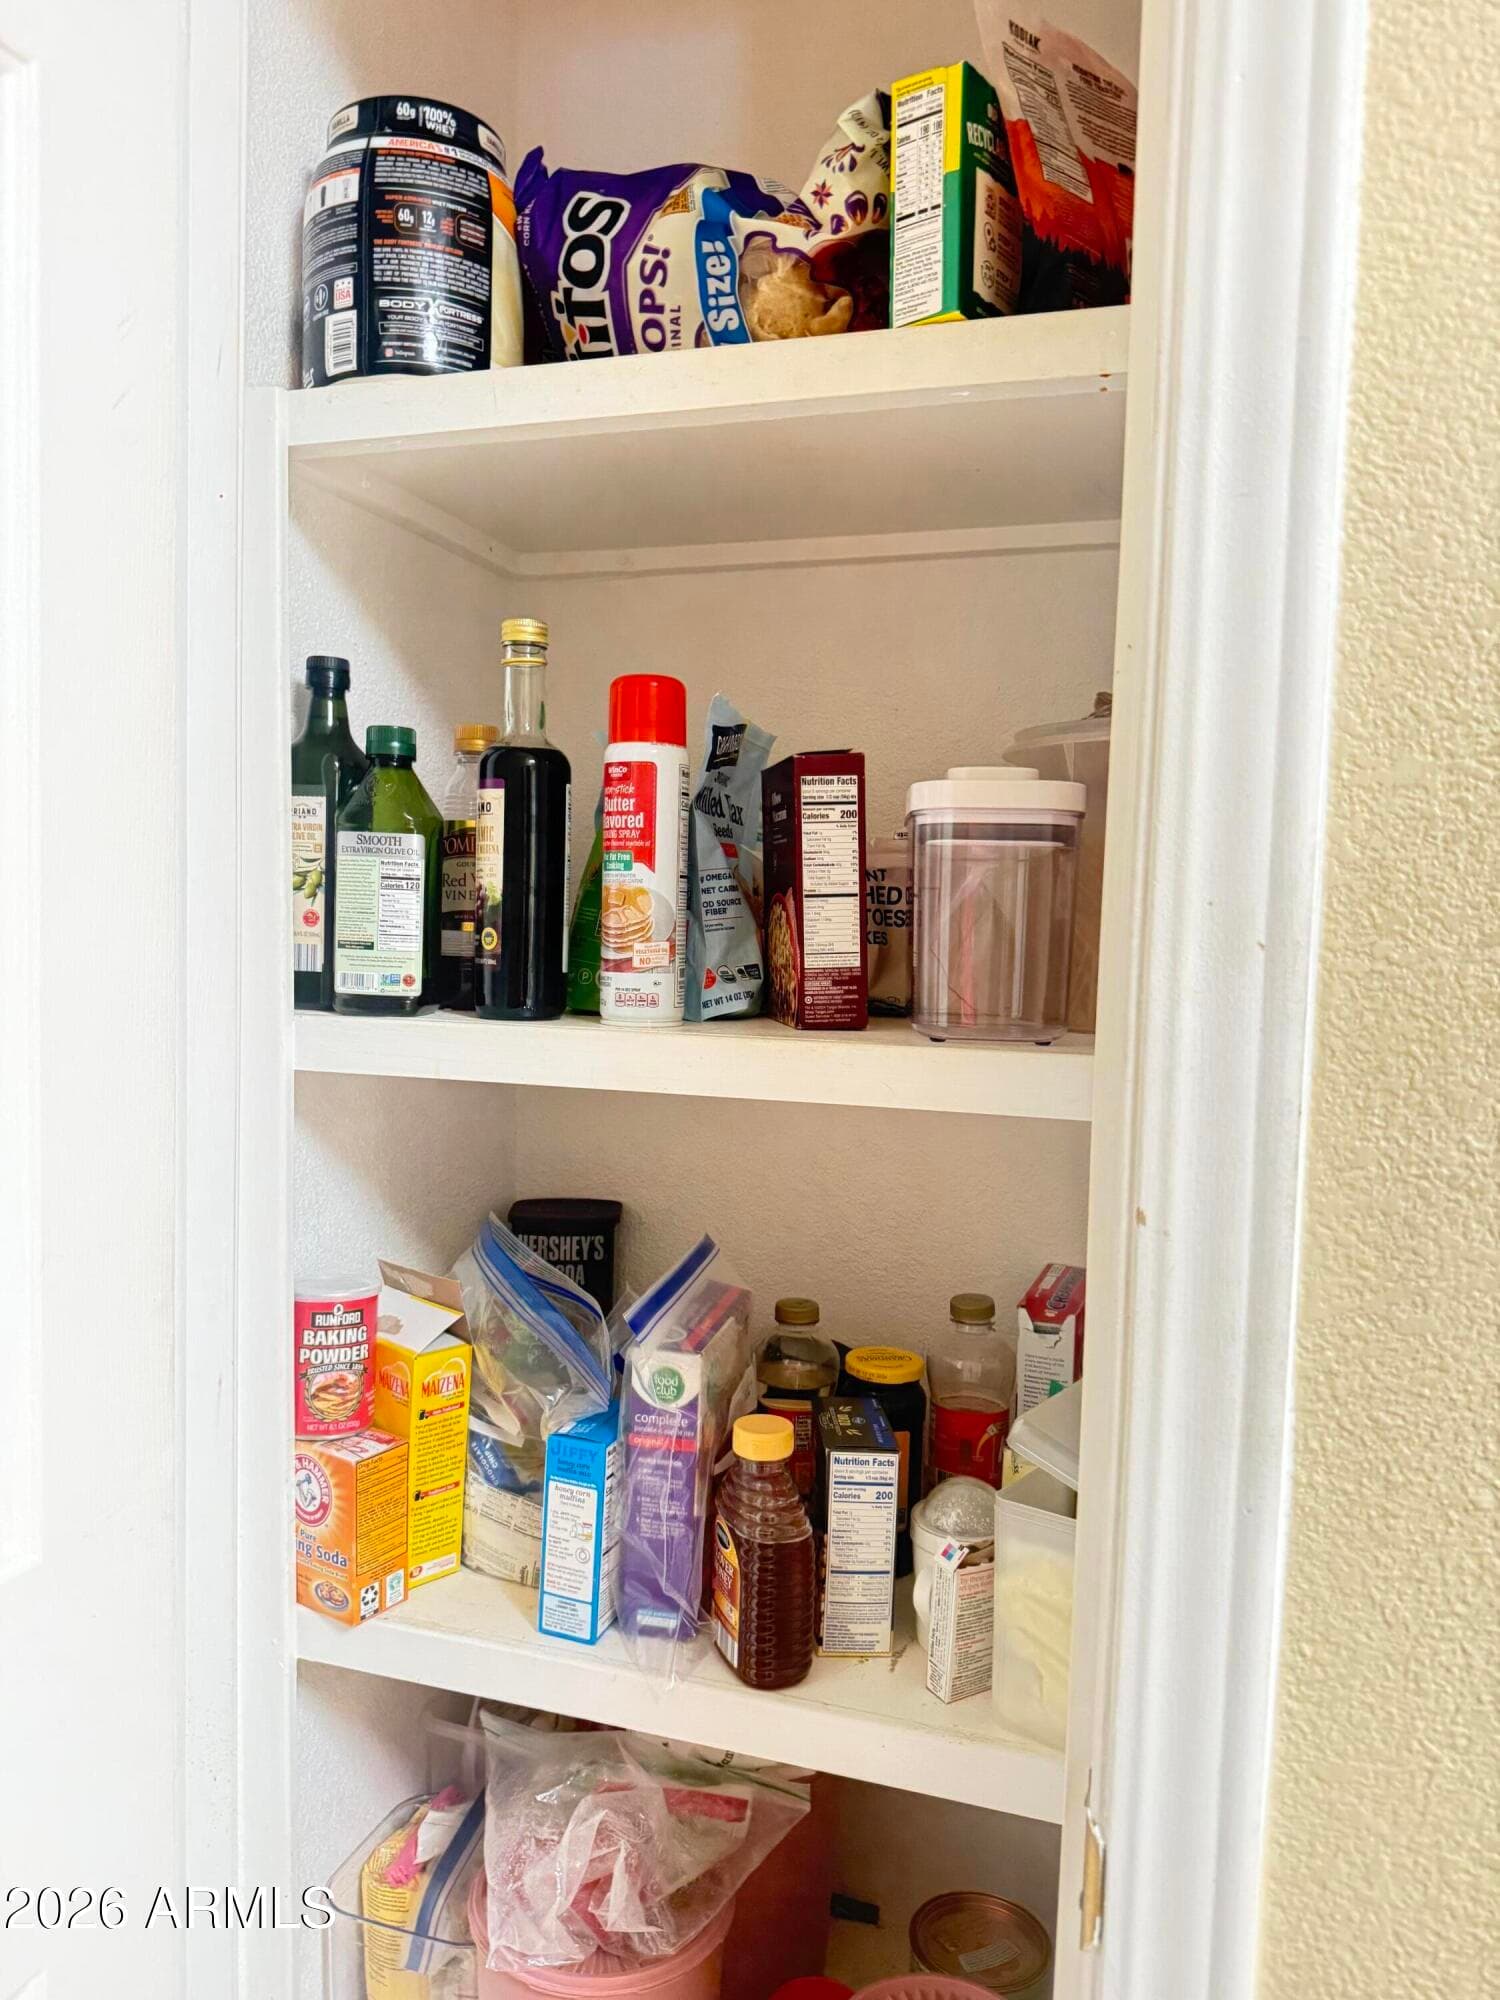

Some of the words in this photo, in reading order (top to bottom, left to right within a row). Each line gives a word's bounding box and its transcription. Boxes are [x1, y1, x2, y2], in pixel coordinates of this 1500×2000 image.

[1009, 19, 1041, 50] KODIAK
[396, 102, 415, 118] 60g
[425, 119, 456, 137] WHEY
[701, 240, 740, 332] Size!
[336, 290, 351, 301] USA
[379, 299, 426, 310] BODY
[438, 304, 484, 324] FORTRESS
[801, 776, 835, 787] Nutrition
[836, 776, 857, 786] Facts
[802, 812, 830, 820] Calories
[840, 809, 857, 819] 200
[303, 823, 323, 832] VIRGIN
[618, 829, 641, 839] SPRAY
[713, 822, 734, 839] Seeds
[356, 833, 402, 847] SMOOTH
[341, 845, 360, 854] EXTRA
[360, 846, 383, 854] VIRGIN
[384, 846, 406, 856] OLIVE
[380, 882, 404, 890] Calories
[405, 881, 420, 890] 120
[442, 872, 467, 888] Red
[701, 886, 716, 895] NET
[717, 898, 742, 907] SOURCE
[639, 957, 651, 966] NO
[702, 999, 713, 1010] NET
[714, 996, 724, 1006] WT
[725, 994, 733, 1003] 14
[734, 992, 743, 1001] OZ
[315, 1311, 362, 1327] RUMFORD
[303, 1325, 368, 1346] BAKING
[299, 1343, 369, 1365] POWDER
[334, 1363, 350, 1371] SINCE
[378, 1370, 410, 1397] MAIZENA
[421, 1373, 465, 1399] MAIZENA
[653, 1374, 679, 1386] food
[655, 1385, 678, 1397] club
[551, 1439, 599, 1463] JIFFY
[833, 1455, 870, 1466] Nutrition
[872, 1457, 895, 1467] Facts
[302, 1457, 330, 1505] HAMMER
[555, 1483, 574, 1495] honey
[575, 1488, 591, 1498] corn
[833, 1491, 861, 1500] Calories
[875, 1490, 894, 1500] 200
[559, 1493, 585, 1504] muffins
[300, 1529, 317, 1542] Pure
[316, 1545, 348, 1568] Soda
